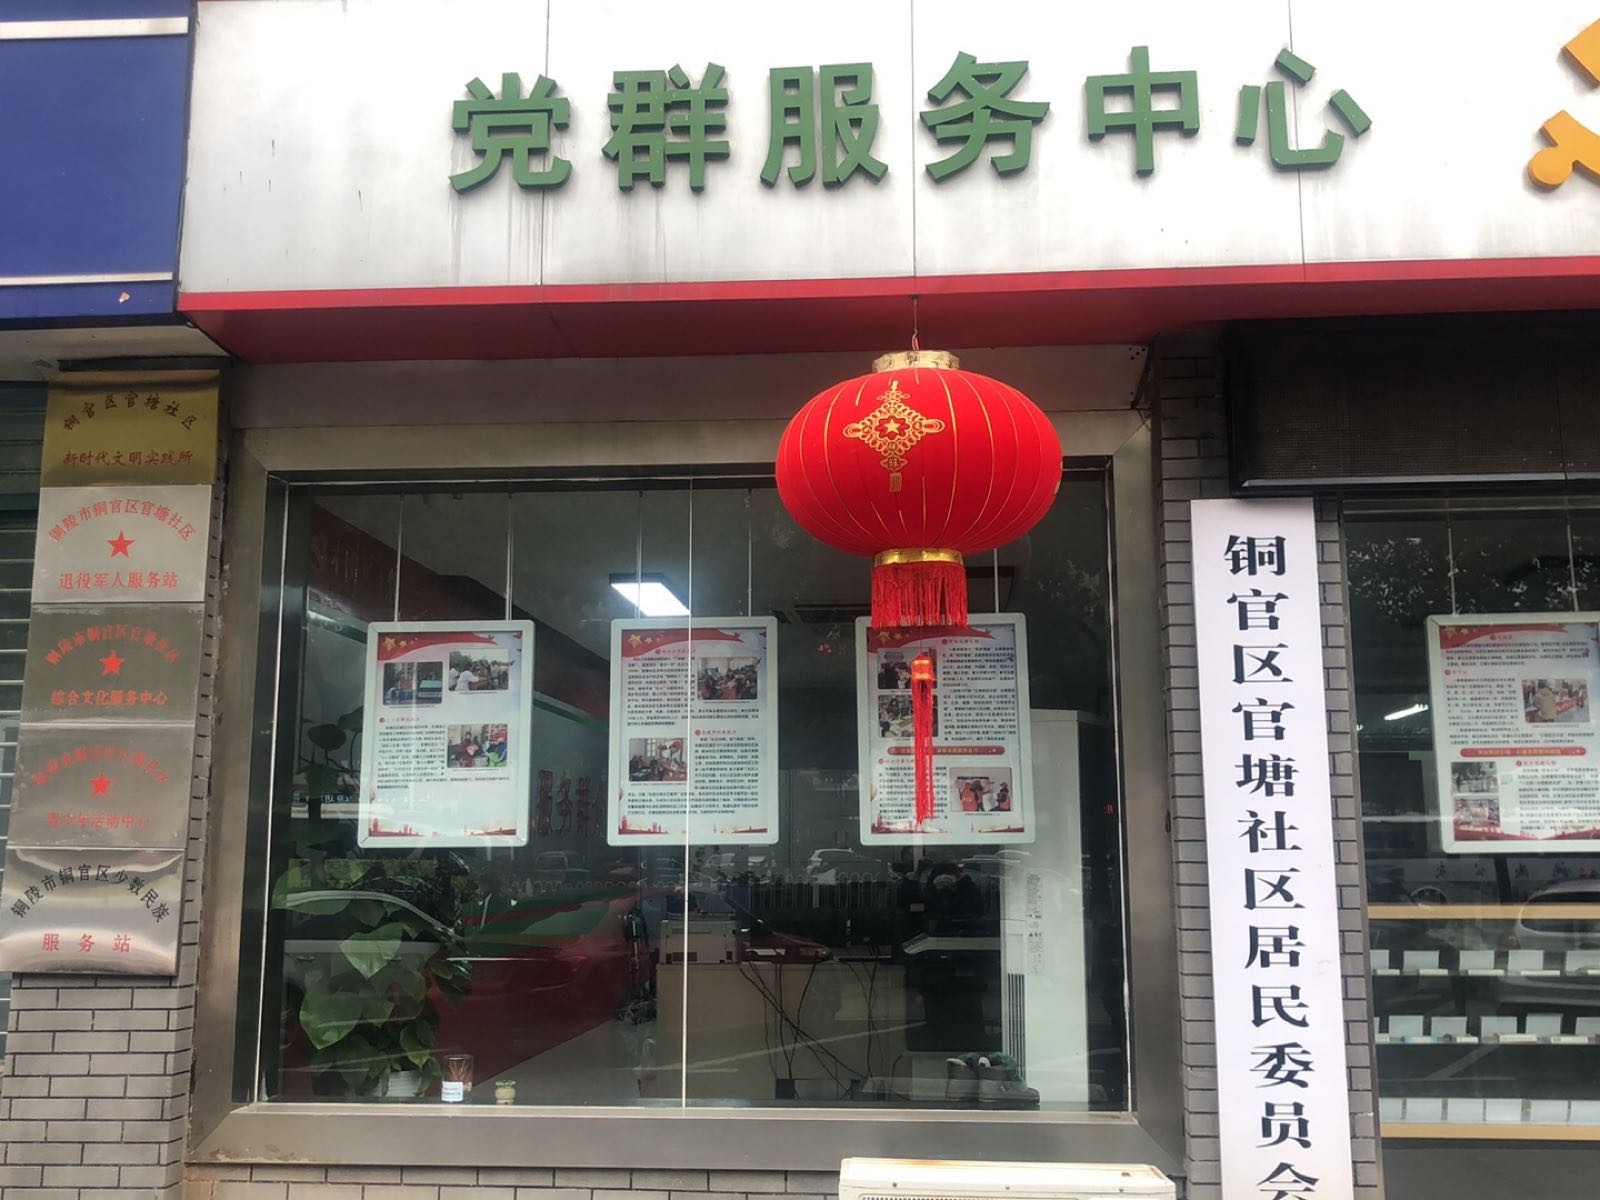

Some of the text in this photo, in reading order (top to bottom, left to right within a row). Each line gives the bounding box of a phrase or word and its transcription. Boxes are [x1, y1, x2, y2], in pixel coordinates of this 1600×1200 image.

[449, 46, 1372, 192] 党群服务中心
[63, 390, 198, 431] 铜官区官塘社区
[63, 449, 193, 466] 新时代文明实践所
[48, 499, 197, 542] 铜陵市铜官区官塘社区
[58, 571, 179, 590] 退役军人服务站
[1224, 534, 1320, 1200] 铜官区官塘社区居民委员会
[10, 863, 171, 922] 铜陵市铜官区少数民族
[42, 933, 131, 952] 服务站
